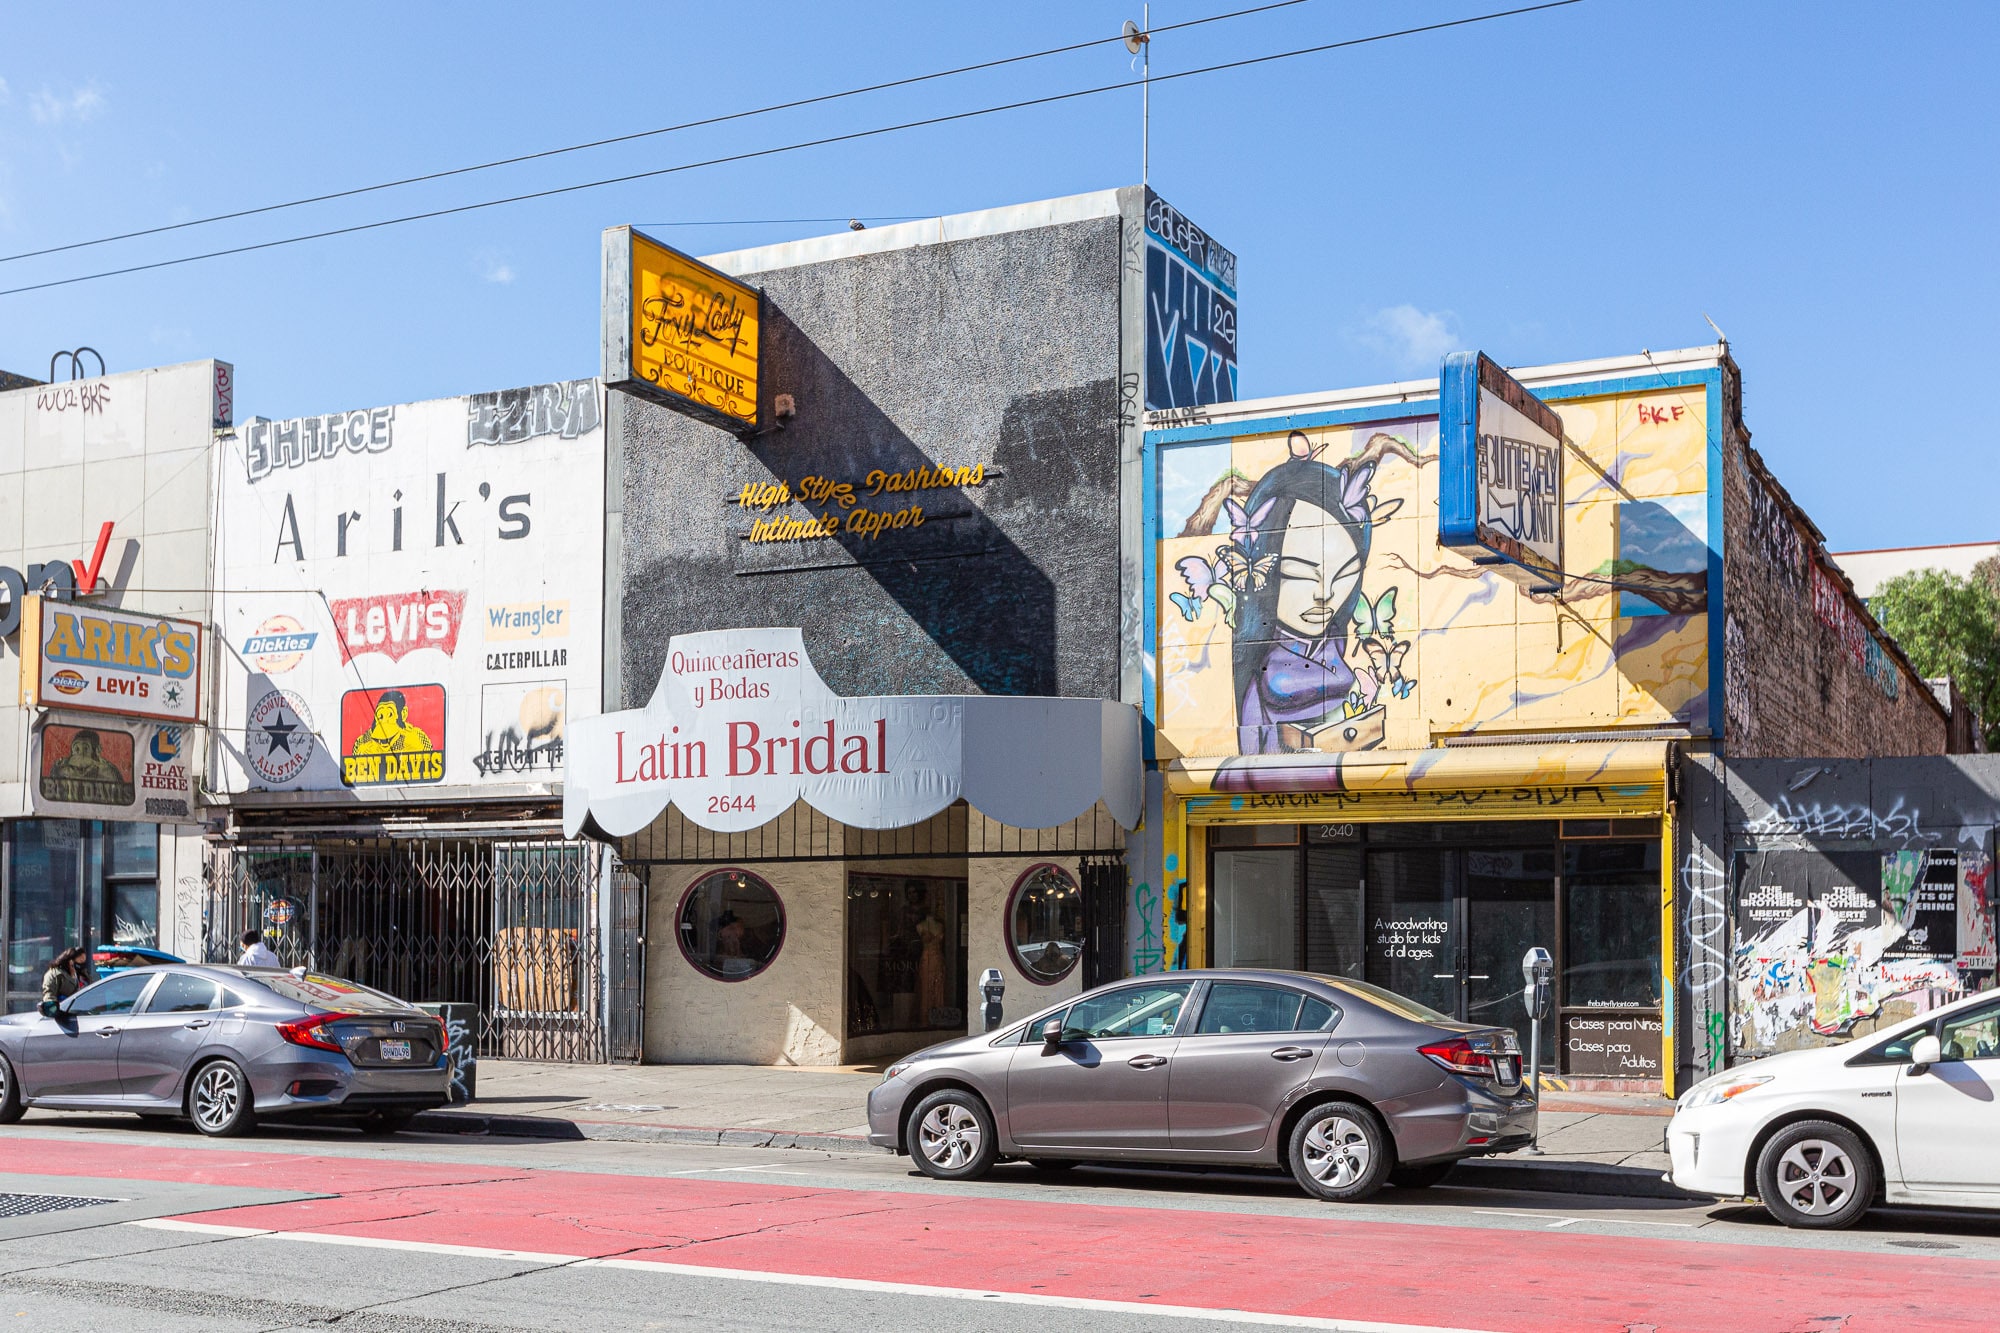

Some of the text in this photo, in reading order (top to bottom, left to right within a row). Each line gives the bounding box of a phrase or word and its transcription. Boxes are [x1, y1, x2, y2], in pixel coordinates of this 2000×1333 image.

[695, 291, 748, 358] Lady
[663, 348, 745, 397] BOUTIQUE
[1638, 403, 1685, 425] BKF
[1487, 433, 1559, 505] BUTTERFLY
[739, 479, 791, 511] High
[866, 463, 985, 496] Fashions
[275, 473, 531, 563] Arik's
[750, 511, 838, 543] Intimate
[489, 604, 564, 636] Wrangler
[46, 612, 195, 679] ARIK'S
[249, 635, 310, 653] Dickies
[486, 649, 568, 671] CATERPILLAR
[672, 648, 799, 675] Quinceañeras
[694, 676, 770, 709] y Bodas
[614, 725, 708, 784] Latin
[724, 718, 891, 777] Bridal
[145, 762, 186, 778] PLAY
[277, 753, 303, 776] STAR
[344, 752, 444, 783] BEN DAVIS
[141, 775, 189, 792] HERE
[707, 794, 756, 814] 2644
[1321, 823, 1354, 838] 2640
[1748, 892, 1794, 900] DOOBIE
[1760, 886, 1782, 894] THE
[1821, 893, 1868, 901] DOOBIE
[1740, 899, 1803, 907] BROTHERS
[1749, 907, 1793, 918] LIBERTÉ
[1374, 916, 1448, 933] A woodworking
[1377, 930, 1441, 944] studio for kids
[1384, 944, 1434, 960] of all ages.
[1587, 999, 1640, 1008] thebutterflyjoint.com
[1607, 1021, 1633, 1036] para
[1633, 1017, 1662, 1031] Niños
[1606, 1043, 1631, 1058] para
[1619, 1054, 1657, 1069] Adultos
